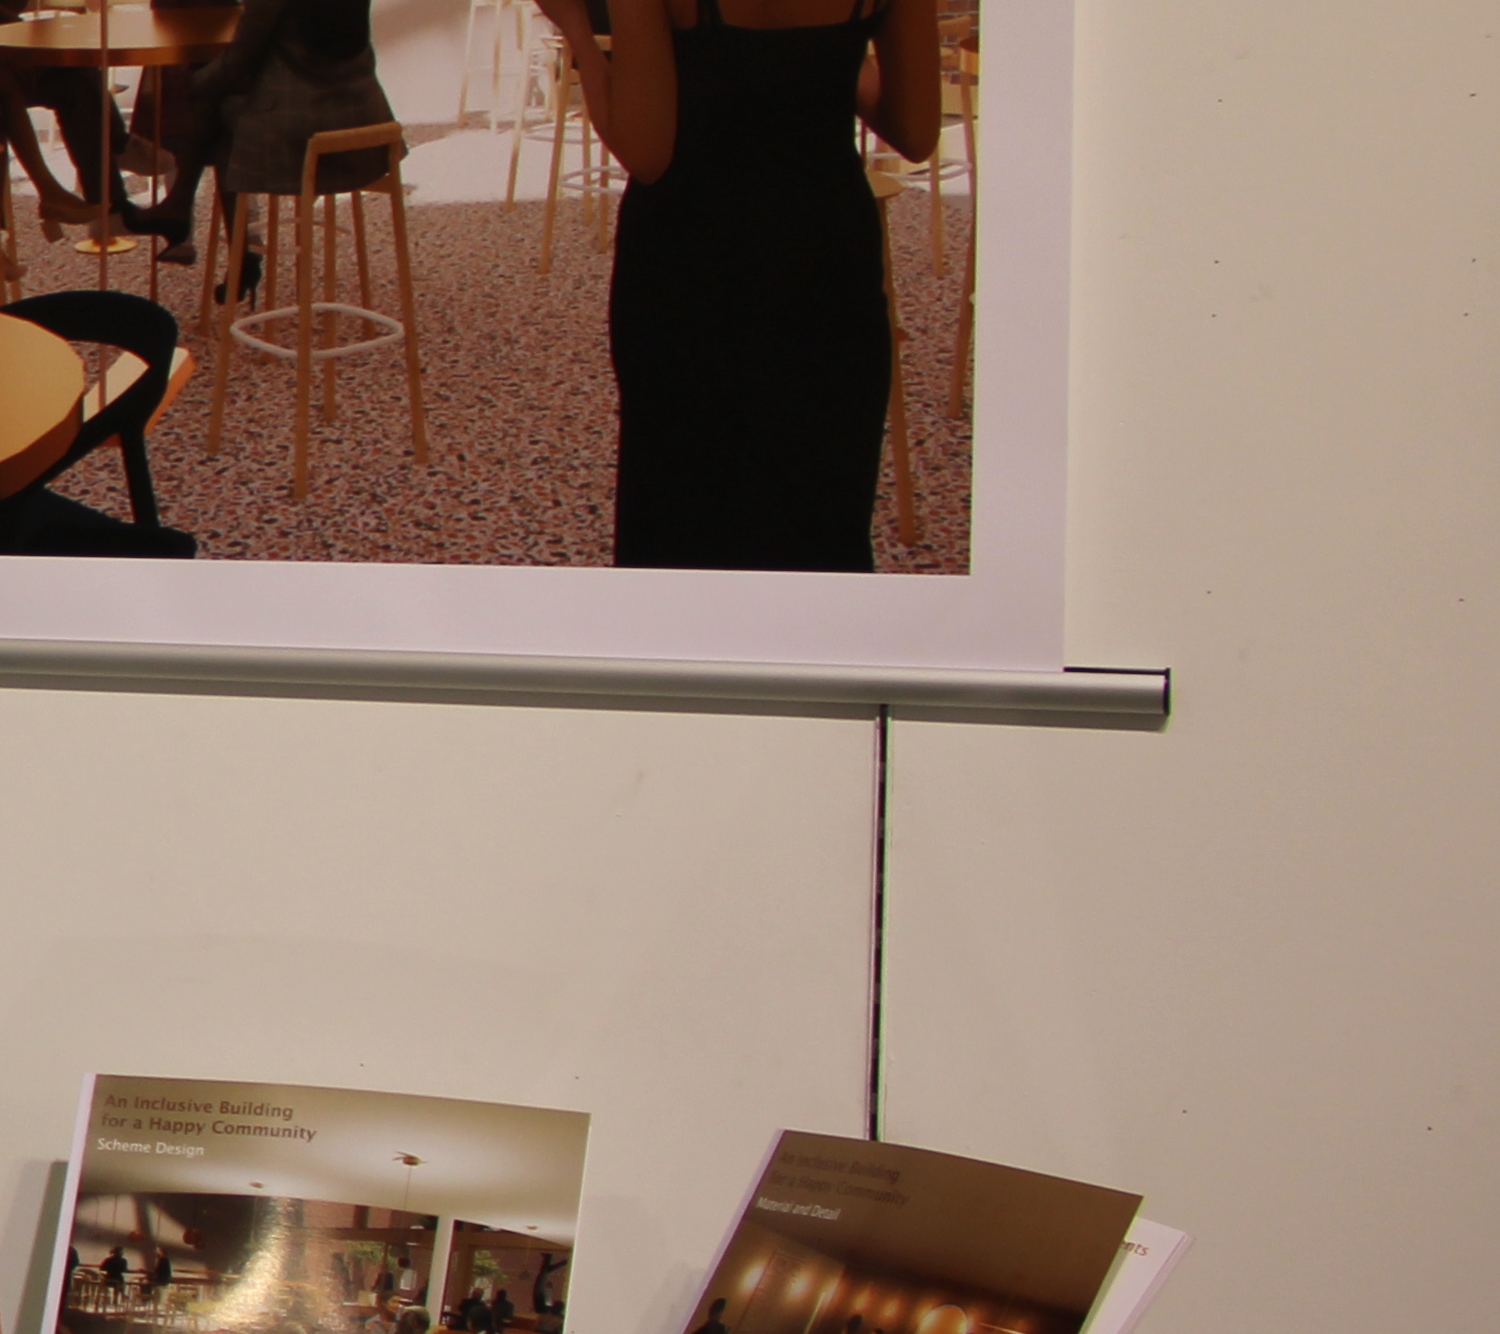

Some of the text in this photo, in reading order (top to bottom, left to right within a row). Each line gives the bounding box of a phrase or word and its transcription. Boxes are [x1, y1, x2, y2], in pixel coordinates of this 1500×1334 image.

[105, 1094, 294, 1122] An Inclusive Building
[101, 1114, 317, 1143] for a Happy Community
[97, 1138, 204, 1158] Scheme Design
[756, 1196, 842, 1220] Material and Detail
